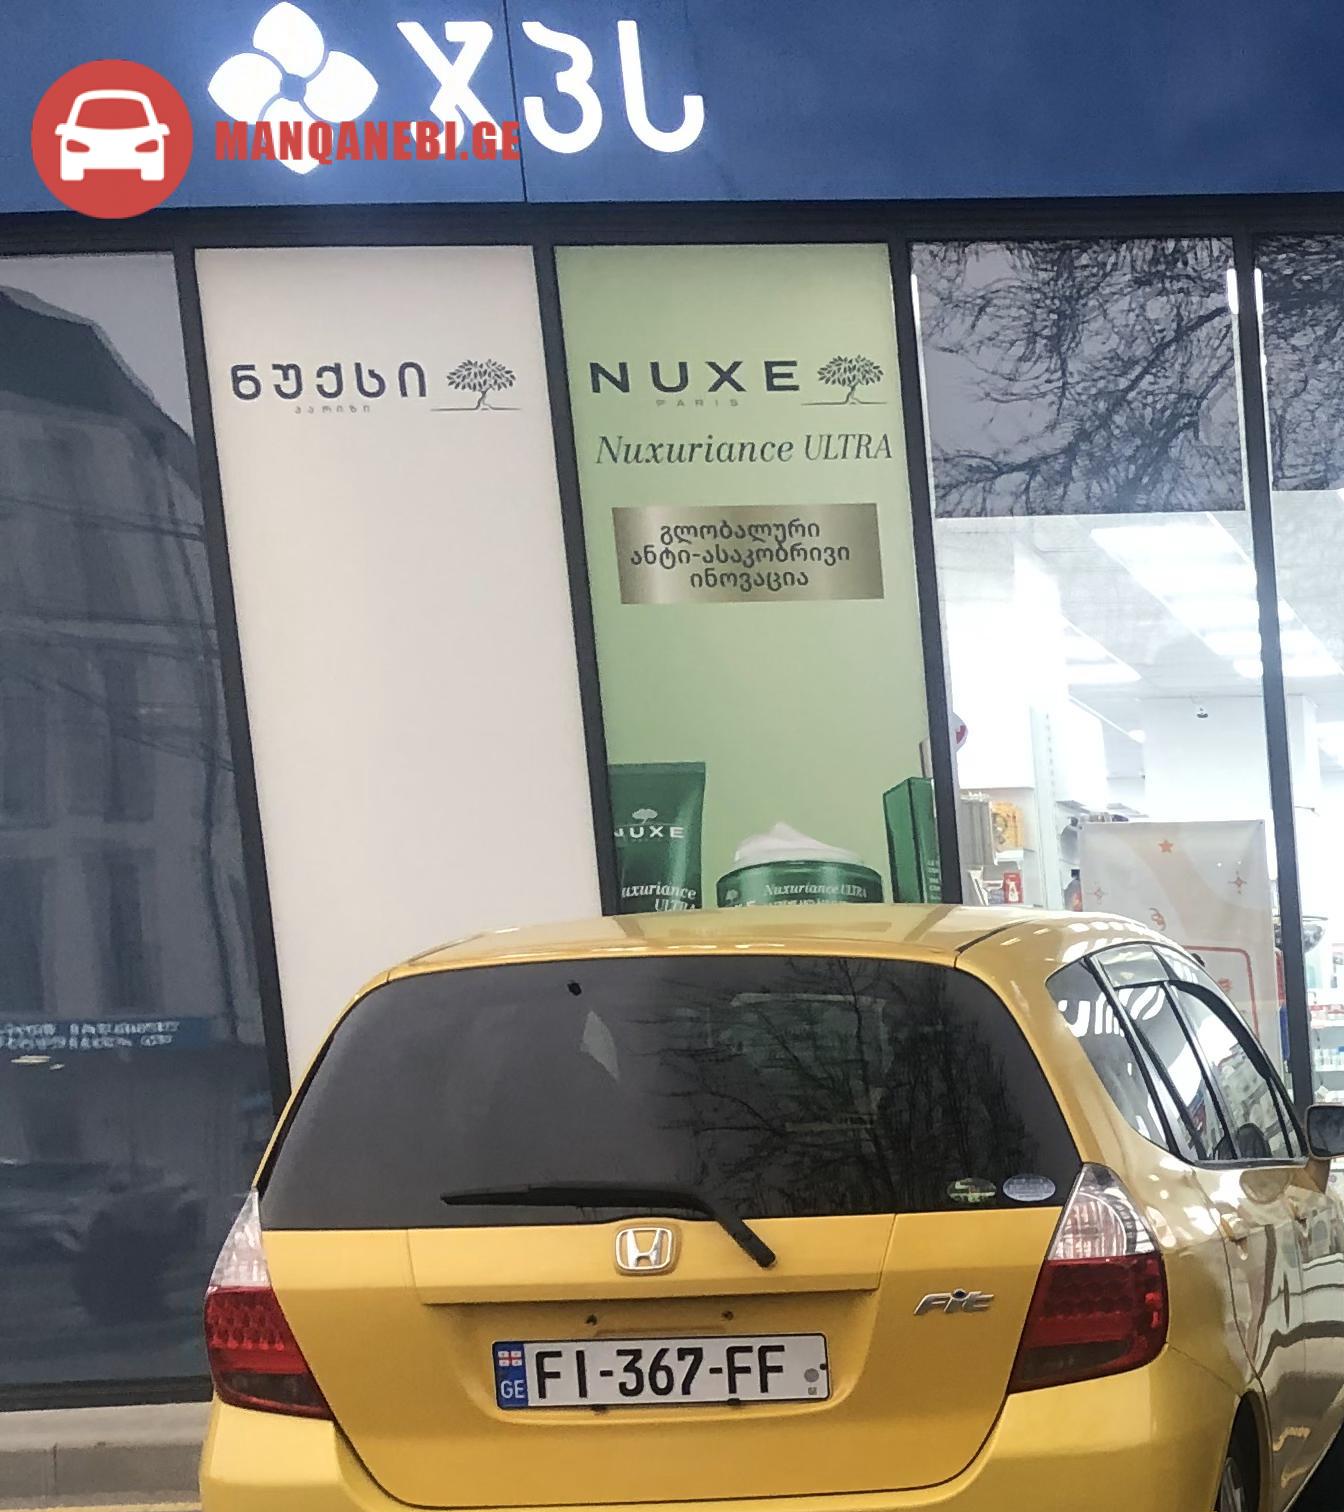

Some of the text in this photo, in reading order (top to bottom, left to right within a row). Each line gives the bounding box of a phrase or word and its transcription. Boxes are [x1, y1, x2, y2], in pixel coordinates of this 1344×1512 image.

[231, 361, 427, 400] ნუქსი
[589, 360, 800, 394] NUXE
[655, 399, 739, 408] PARIS
[596, 432, 893, 465] Nuxuriance ULTRA
[660, 518, 820, 546] გლობალური
[630, 543, 850, 570] ანტი-ასაკობრივი
[690, 567, 809, 593] ინოვაცია
[621, 881, 697, 900] uxuriance
[765, 882, 838, 896] Nuxuriance
[500, 1345, 785, 1400] GE FI-367-FF
